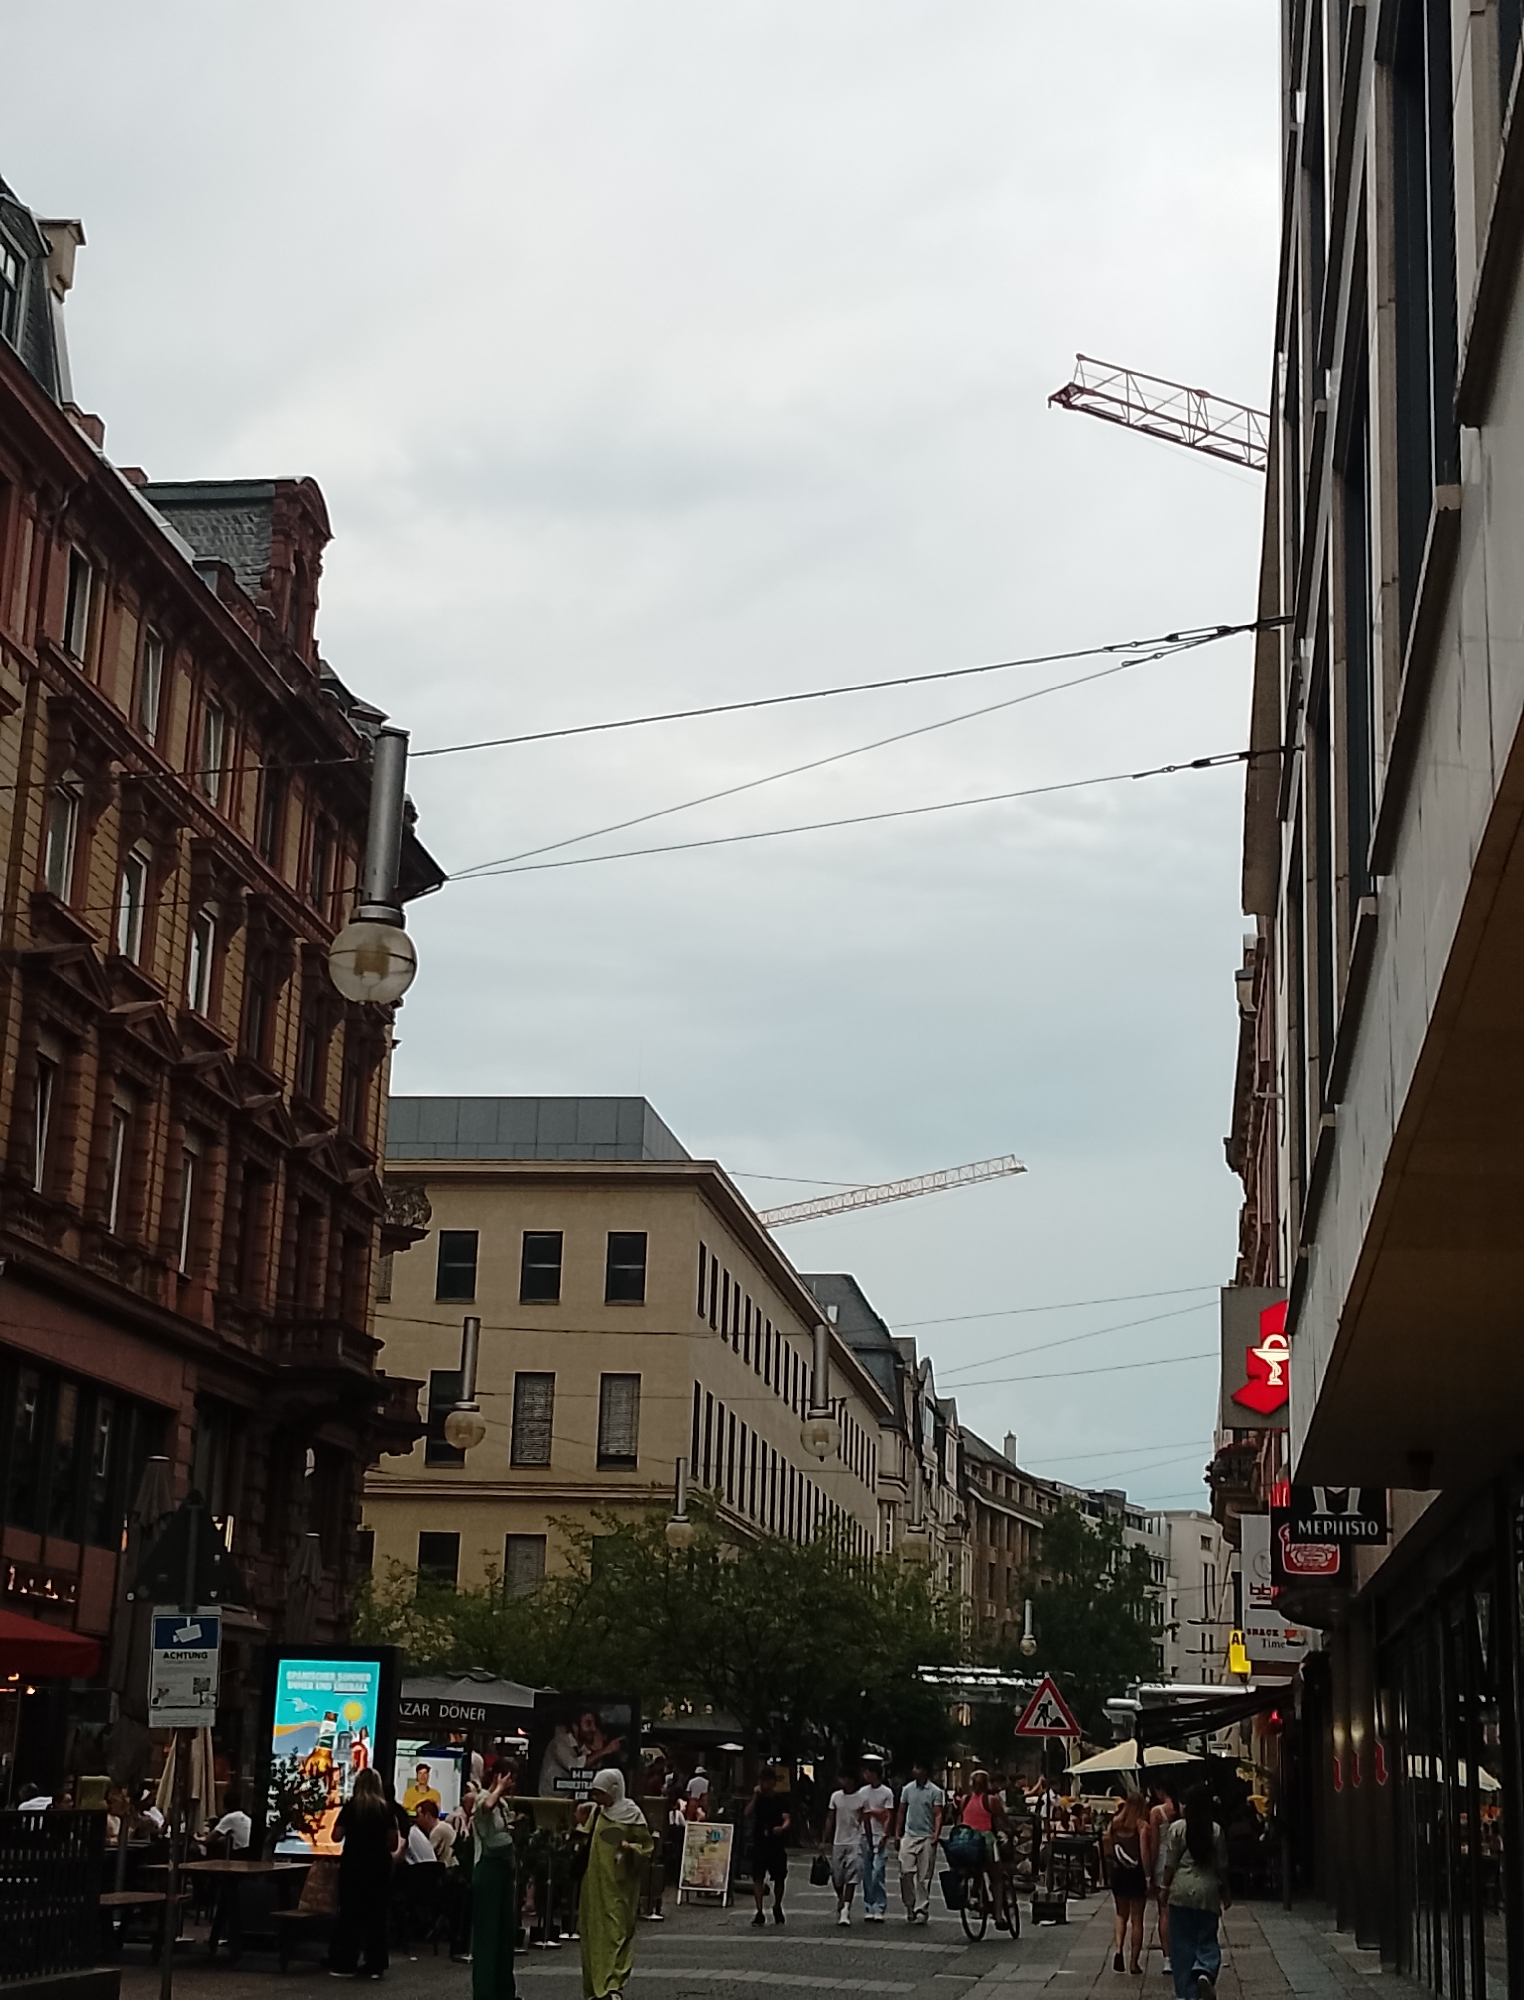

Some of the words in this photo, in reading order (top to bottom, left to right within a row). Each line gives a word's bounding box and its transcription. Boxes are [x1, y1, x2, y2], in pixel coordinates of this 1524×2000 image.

[1298, 1520, 1379, 1536] MEPHISTO
[1246, 1628, 1280, 1637] SNACK
[1262, 1638, 1286, 1648] Time
[163, 1651, 209, 1660] ACHTUNG
[439, 1702, 486, 1721] DÖNER
